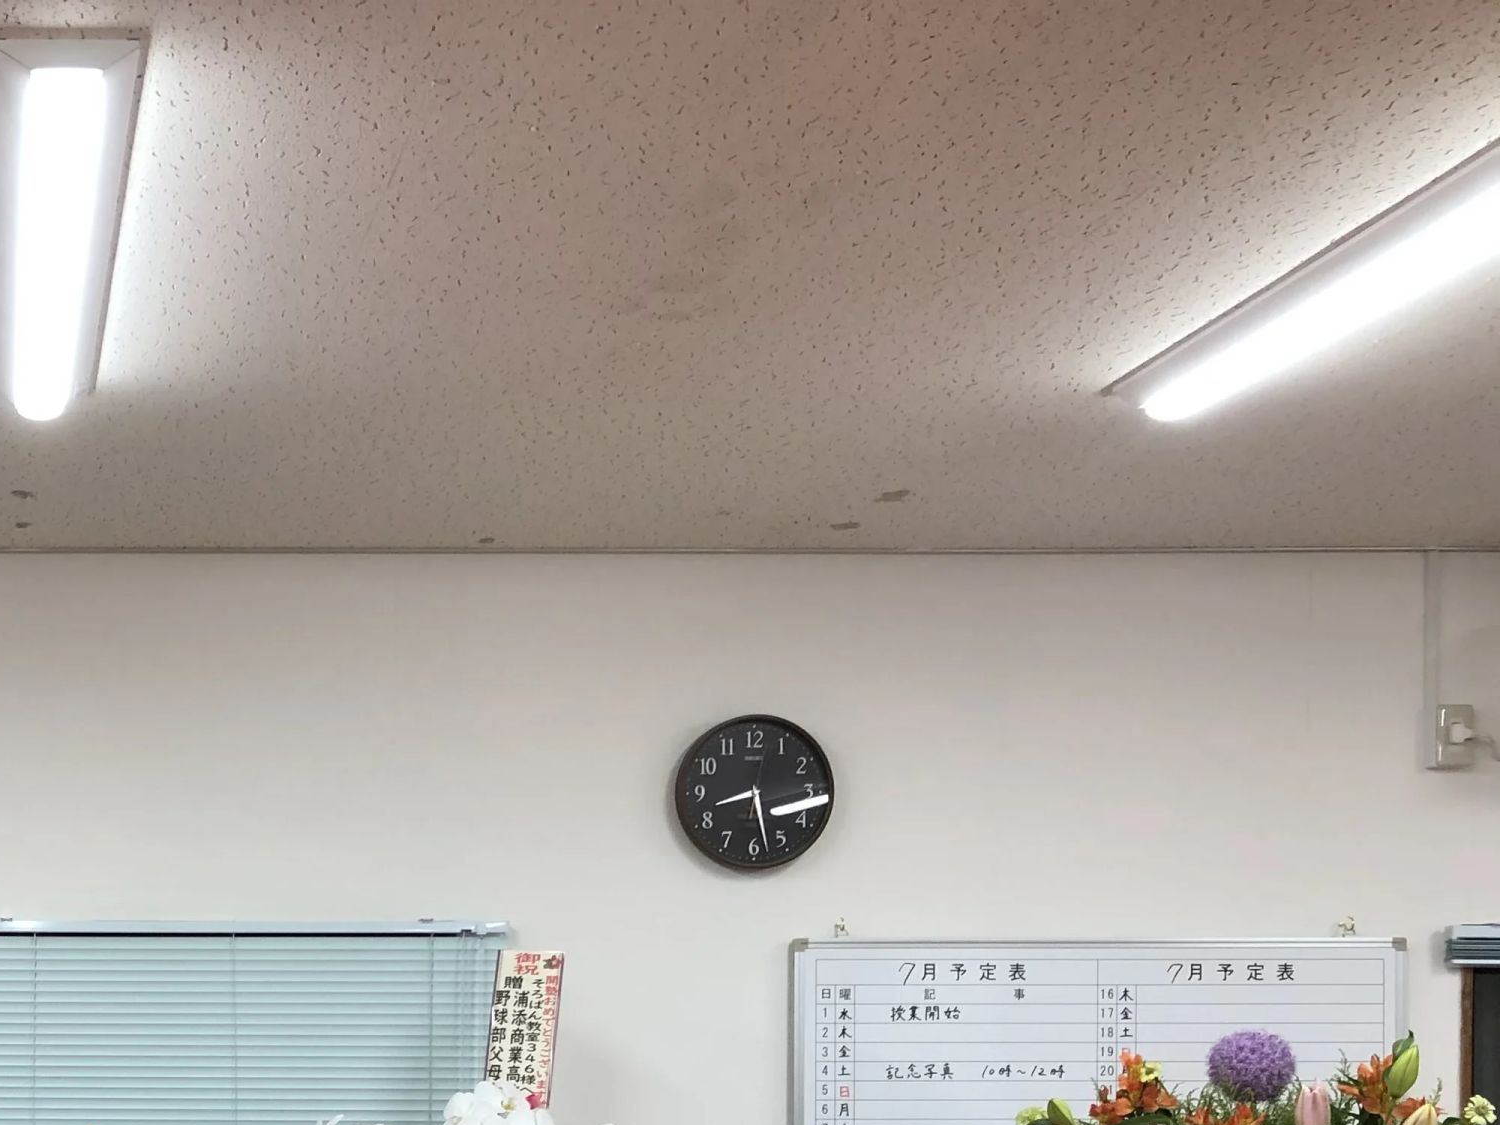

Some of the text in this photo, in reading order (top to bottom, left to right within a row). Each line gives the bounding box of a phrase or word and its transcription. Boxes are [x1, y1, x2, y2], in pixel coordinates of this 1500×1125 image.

[720, 737, 735, 755] 11
[746, 730, 764, 748] 12
[778, 737, 785, 755] 1
[699, 757, 717, 775] 10
[796, 756, 806, 774] 2
[694, 784, 706, 802] 9
[804, 783, 814, 800] 3
[702, 811, 714, 829] 8
[795, 810, 806, 828] 4
[722, 830, 732, 849] 7
[748, 837, 760, 856] 6
[776, 830, 786, 848] 5
[513, 952, 541, 976] 御祝
[503, 975, 524, 989] 贈
[820, 988, 831, 1000] 日
[839, 988, 851, 1000] 曜
[1100, 986, 1134, 1002] 16 木
[822, 1008, 828, 1019] 1
[838, 1007, 852, 1021] 水
[1100, 1006, 1134, 1021] 17 金
[486, 990, 510, 1086] 野球部父母
[506, 990, 530, 1089] 浦添商業高
[822, 1026, 852, 1039] 2 木
[1100, 1026, 1134, 1038] 18 土
[822, 1045, 851, 1058] 3 金
[1100, 1046, 1114, 1058] 19
[822, 1065, 828, 1076] 4
[838, 1064, 851, 1076] 土
[885, 1063, 955, 1080] 記念写真
[1100, 1065, 1114, 1077] 20
[822, 1084, 850, 1098] 5 日
[822, 1104, 850, 1117] 6 月
